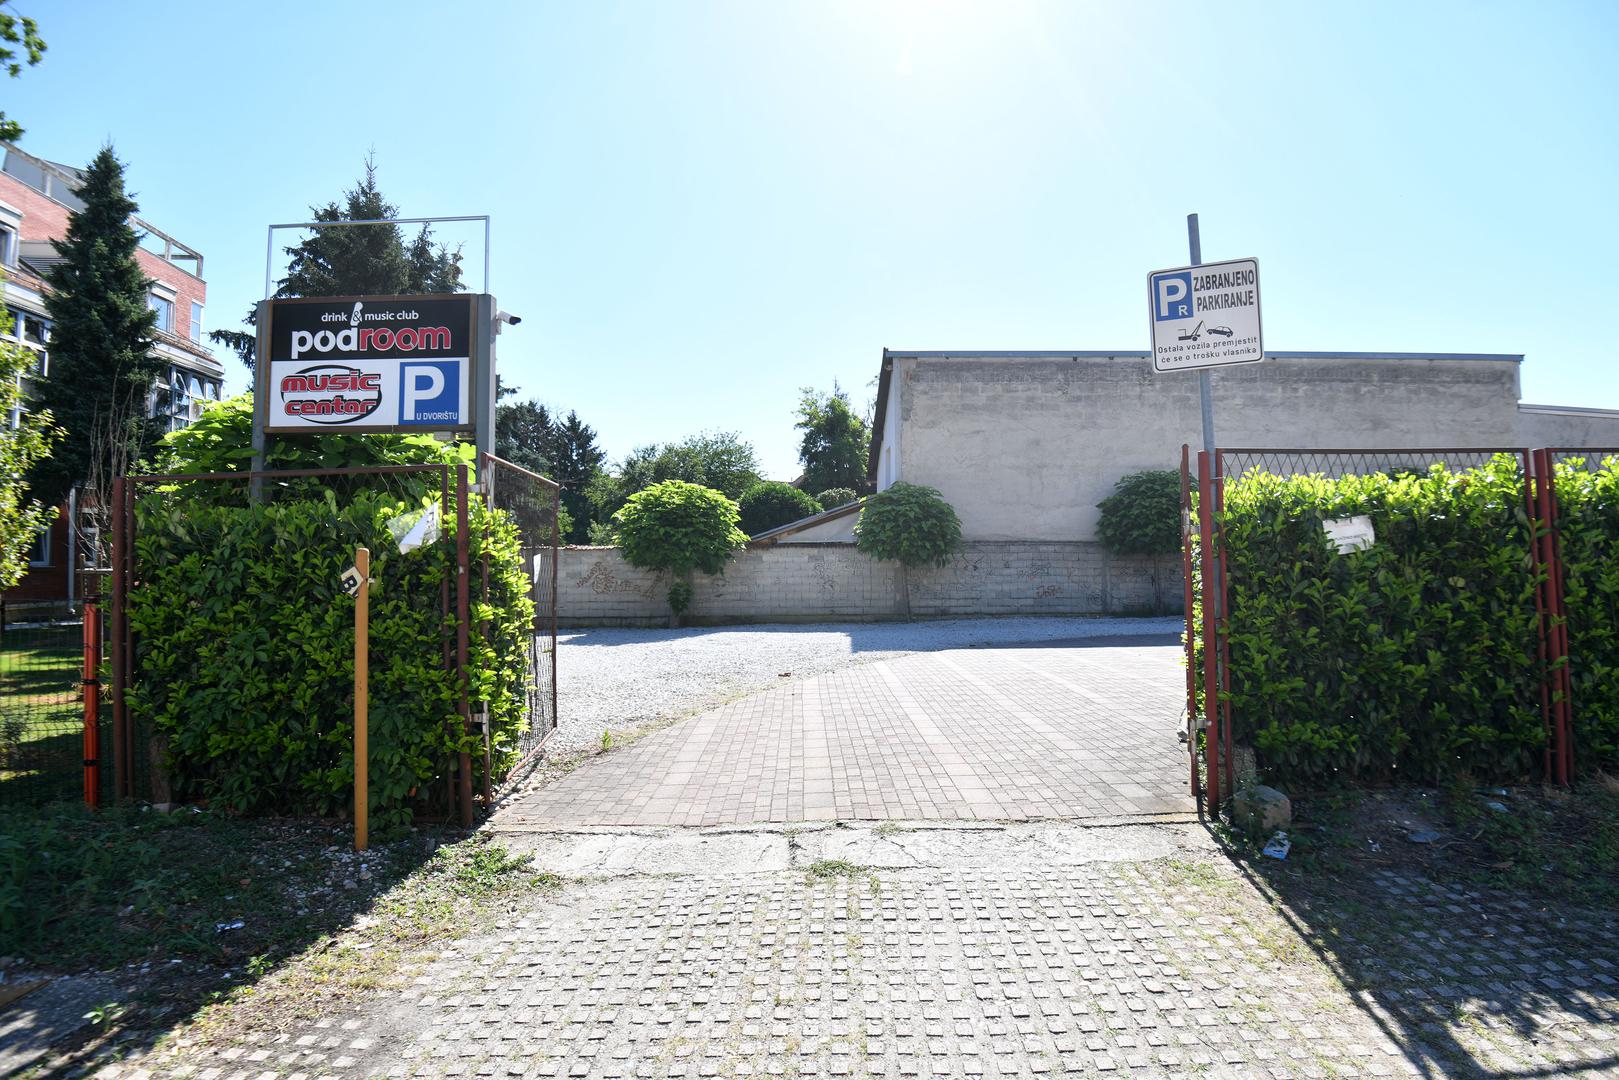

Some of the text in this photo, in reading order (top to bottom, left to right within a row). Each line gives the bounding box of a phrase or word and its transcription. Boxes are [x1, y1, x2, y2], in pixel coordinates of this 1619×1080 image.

[1193, 270, 1254, 291] ZABRANJENO
[1159, 279, 1187, 317] P
[1197, 290, 1254, 312] PARKIRANJE
[321, 312, 348, 322] drink
[364, 311, 394, 321] music
[396, 310, 419, 320] club
[1178, 305, 1188, 316] R
[291, 326, 451, 359] podroom
[1158, 336, 1257, 354] Ostala vozila premjestit
[1193, 350, 1220, 360] trošku
[1222, 347, 1257, 356] vlasnika
[281, 369, 381, 393] music
[404, 366, 445, 421] P
[422, 411, 458, 420] DVORIŠTU
